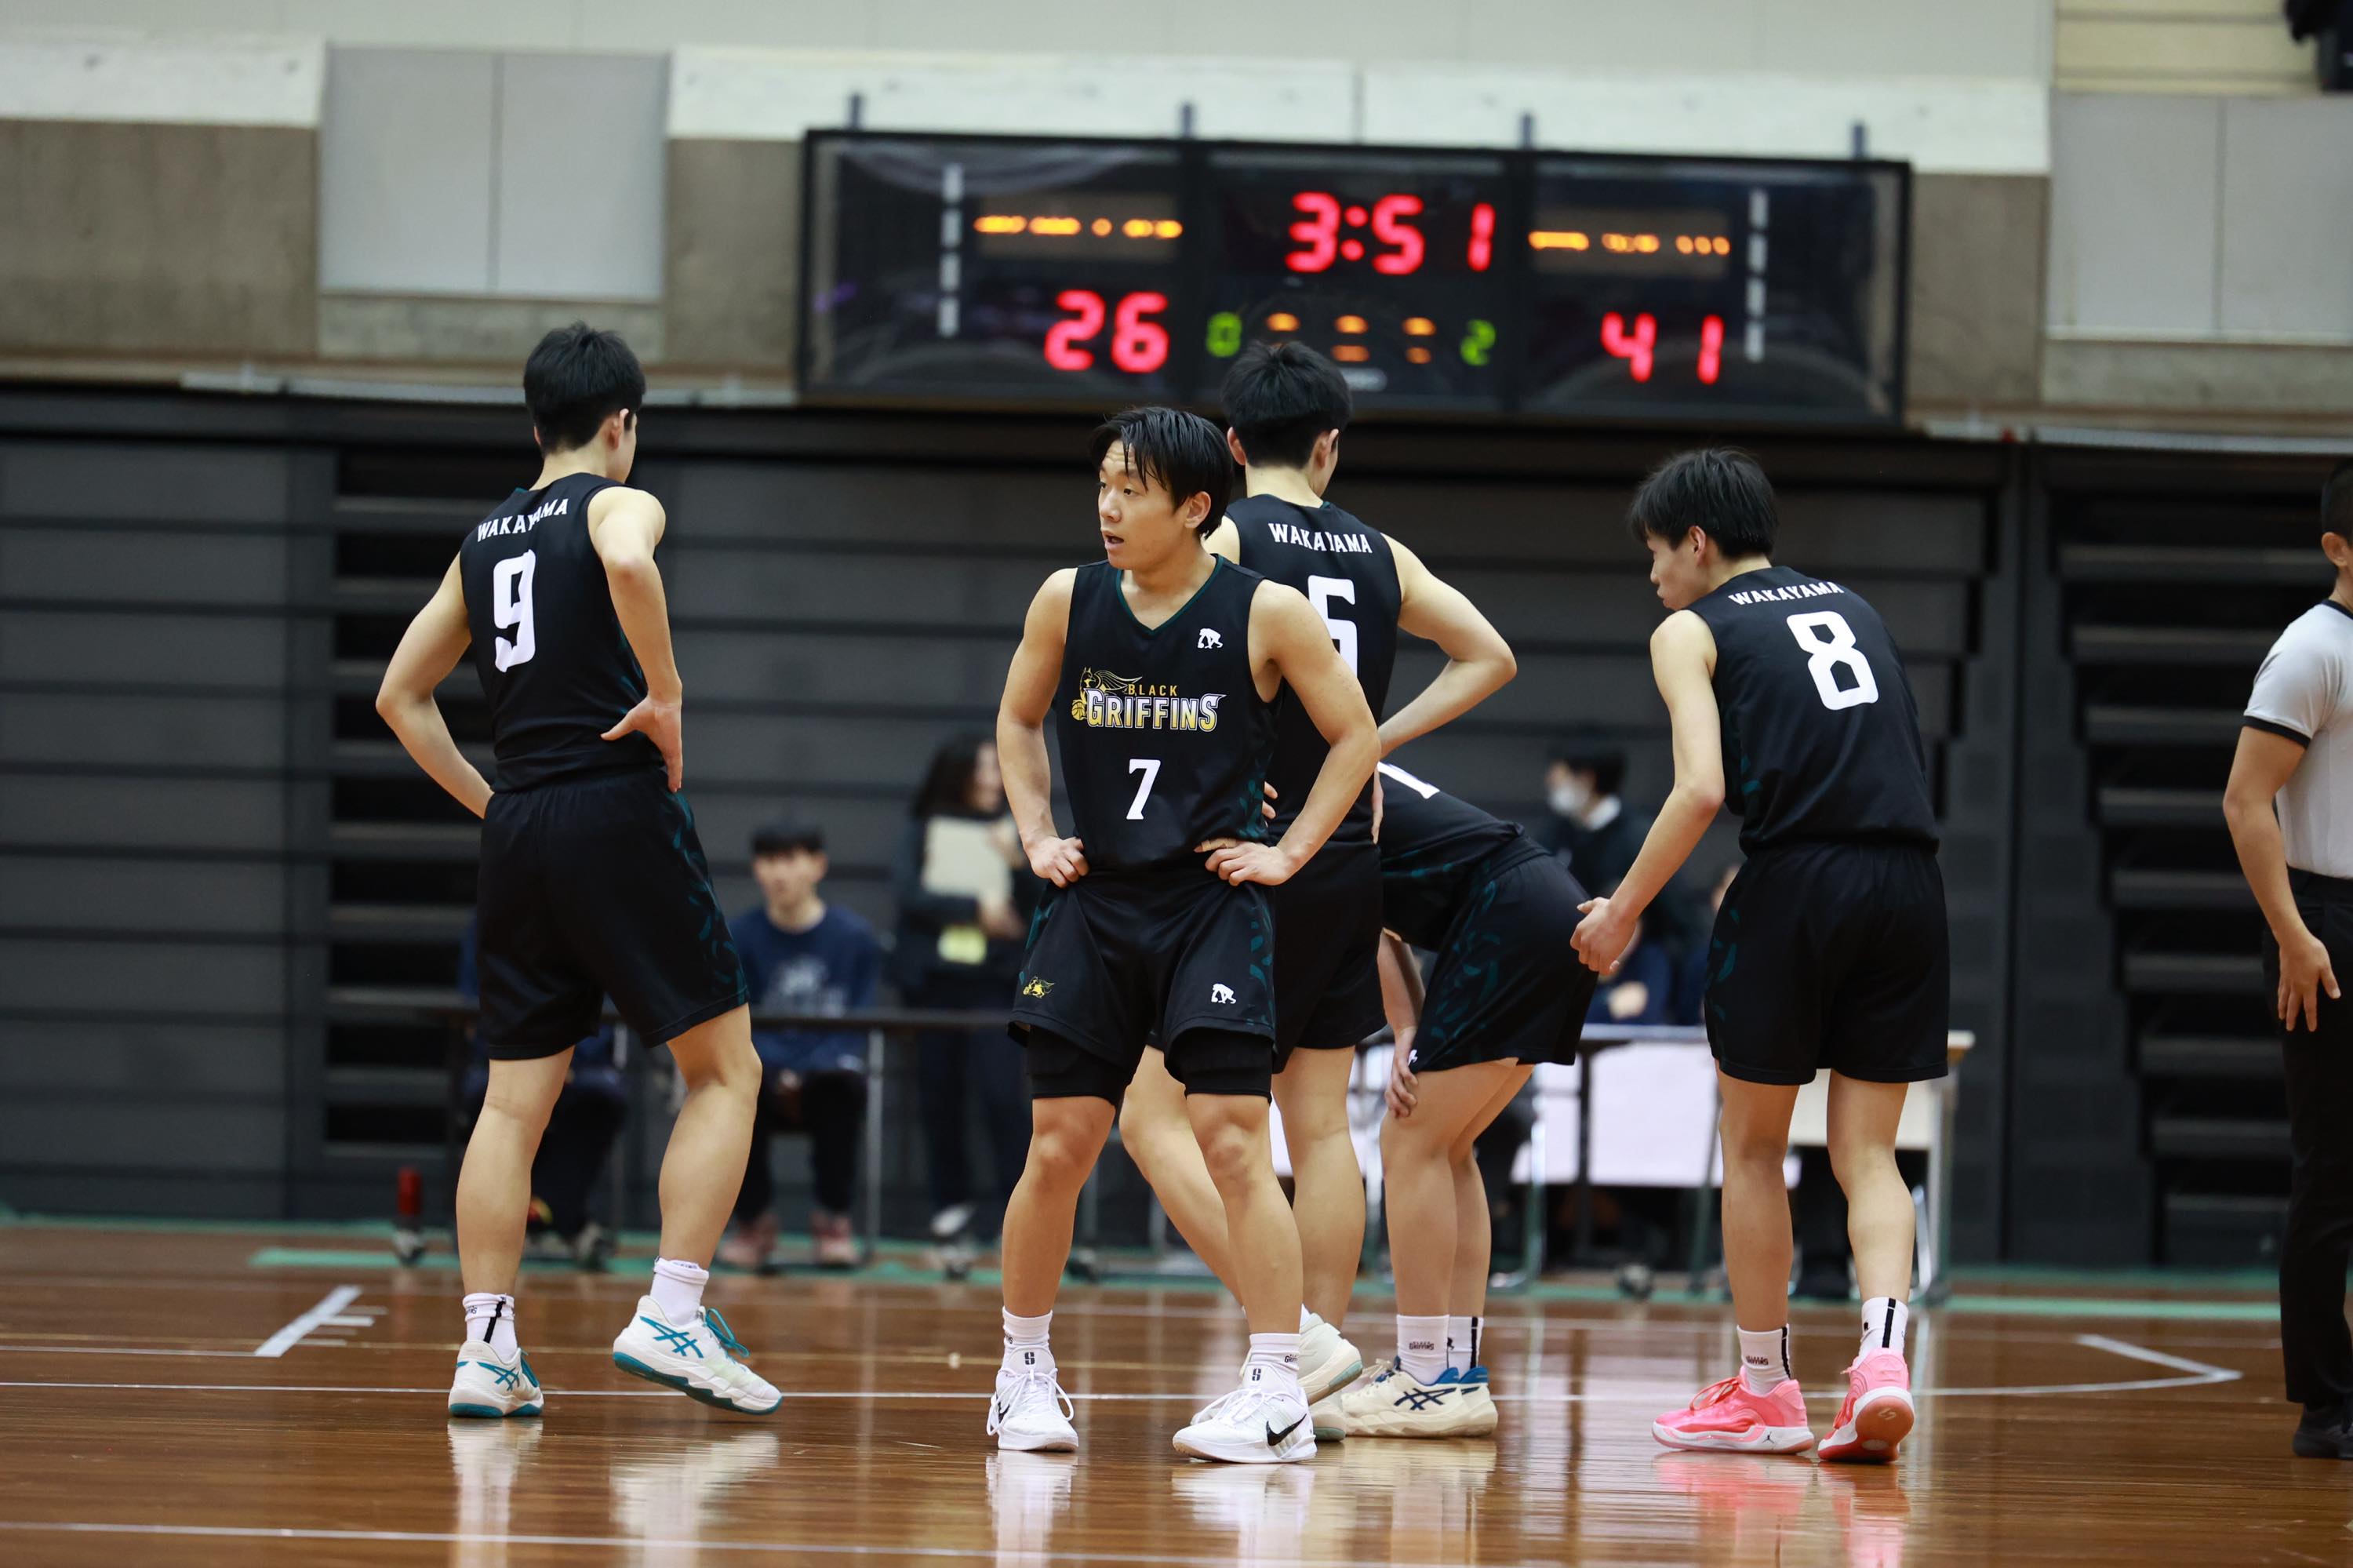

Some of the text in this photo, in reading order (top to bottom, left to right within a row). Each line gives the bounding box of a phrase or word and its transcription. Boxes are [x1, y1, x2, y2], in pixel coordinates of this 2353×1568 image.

[1286, 191, 1496, 275] 3:51
[1044, 289, 1169, 373] 26
[1600, 311, 1725, 385] 41
[493, 549, 536, 673] 9
[1728, 581, 1845, 606] WAKAYAMA
[1127, 683, 1178, 697] BLACK
[1786, 610, 1879, 711] 8
[1083, 687, 1227, 733] GRIFFINS
[1126, 759, 1162, 820] 7
